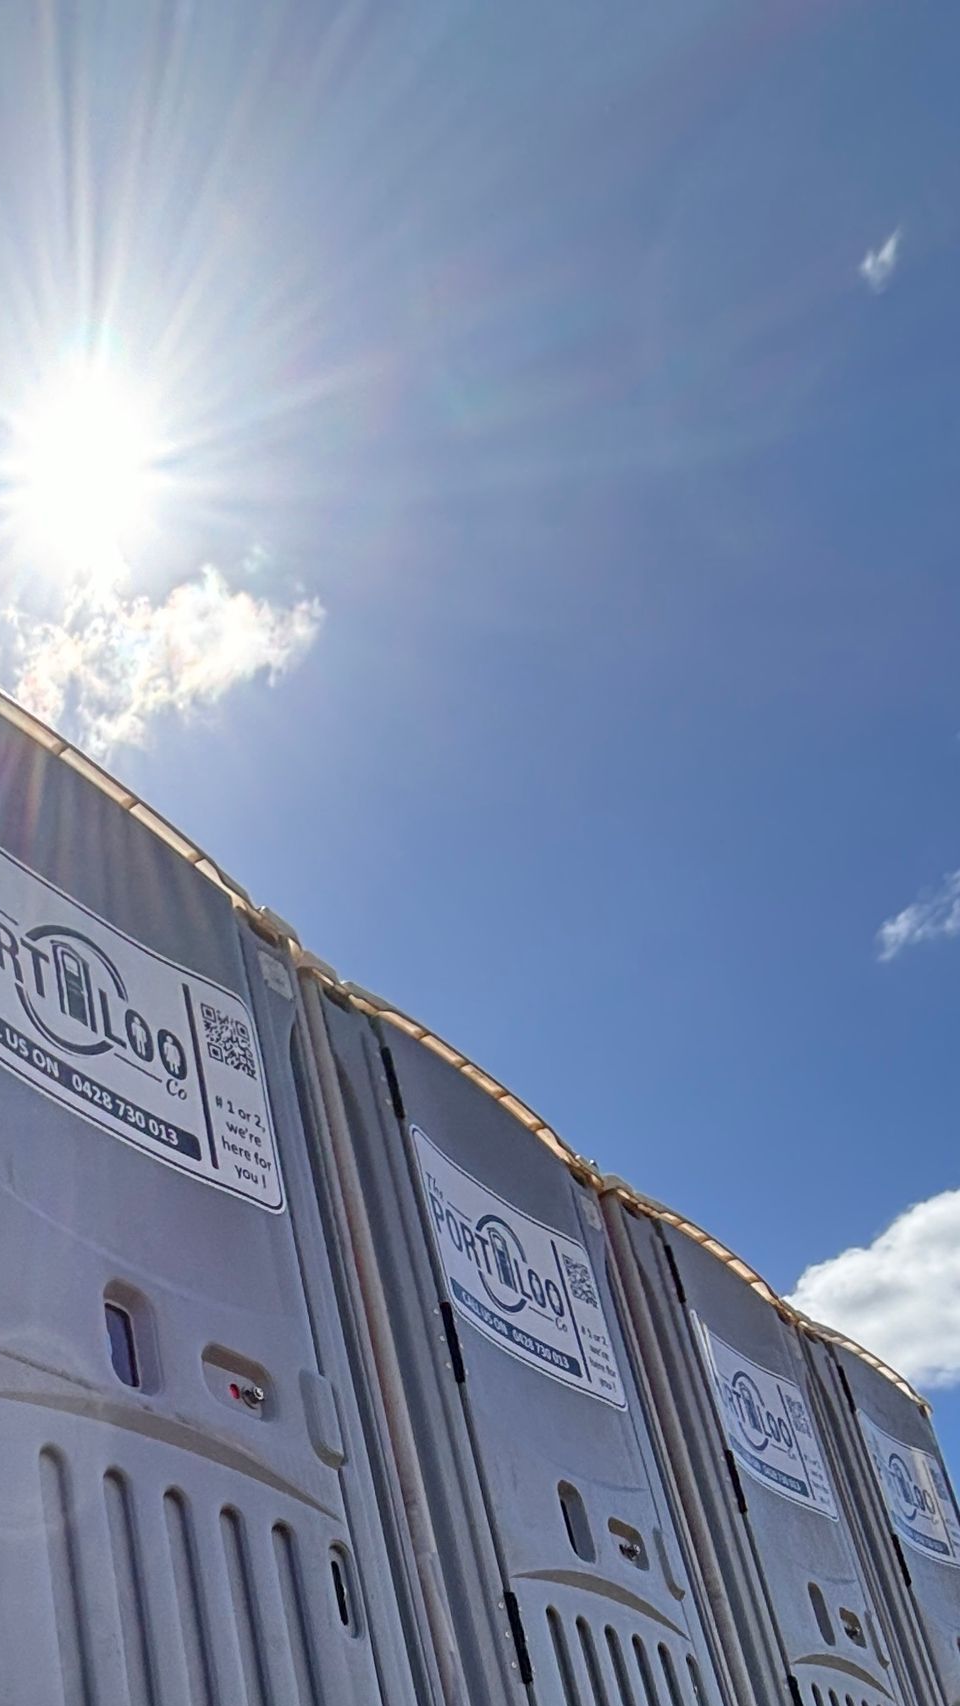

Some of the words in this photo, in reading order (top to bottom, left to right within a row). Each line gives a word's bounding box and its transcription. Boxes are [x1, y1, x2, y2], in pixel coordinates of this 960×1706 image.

[5, 1028, 29, 1057] US
[32, 1048, 59, 1078] ON
[72, 1074, 113, 1110] 0428
[116, 1099, 146, 1128] 730
[149, 1119, 179, 1146] 013
[166, 1078, 187, 1100] Co
[227, 1100, 235, 1114] 1
[238, 1108, 251, 1122] or
[226, 1121, 262, 1147] we're
[221, 1135, 252, 1161] here
[254, 1152, 272, 1172] for
[234, 1164, 258, 1184] you
